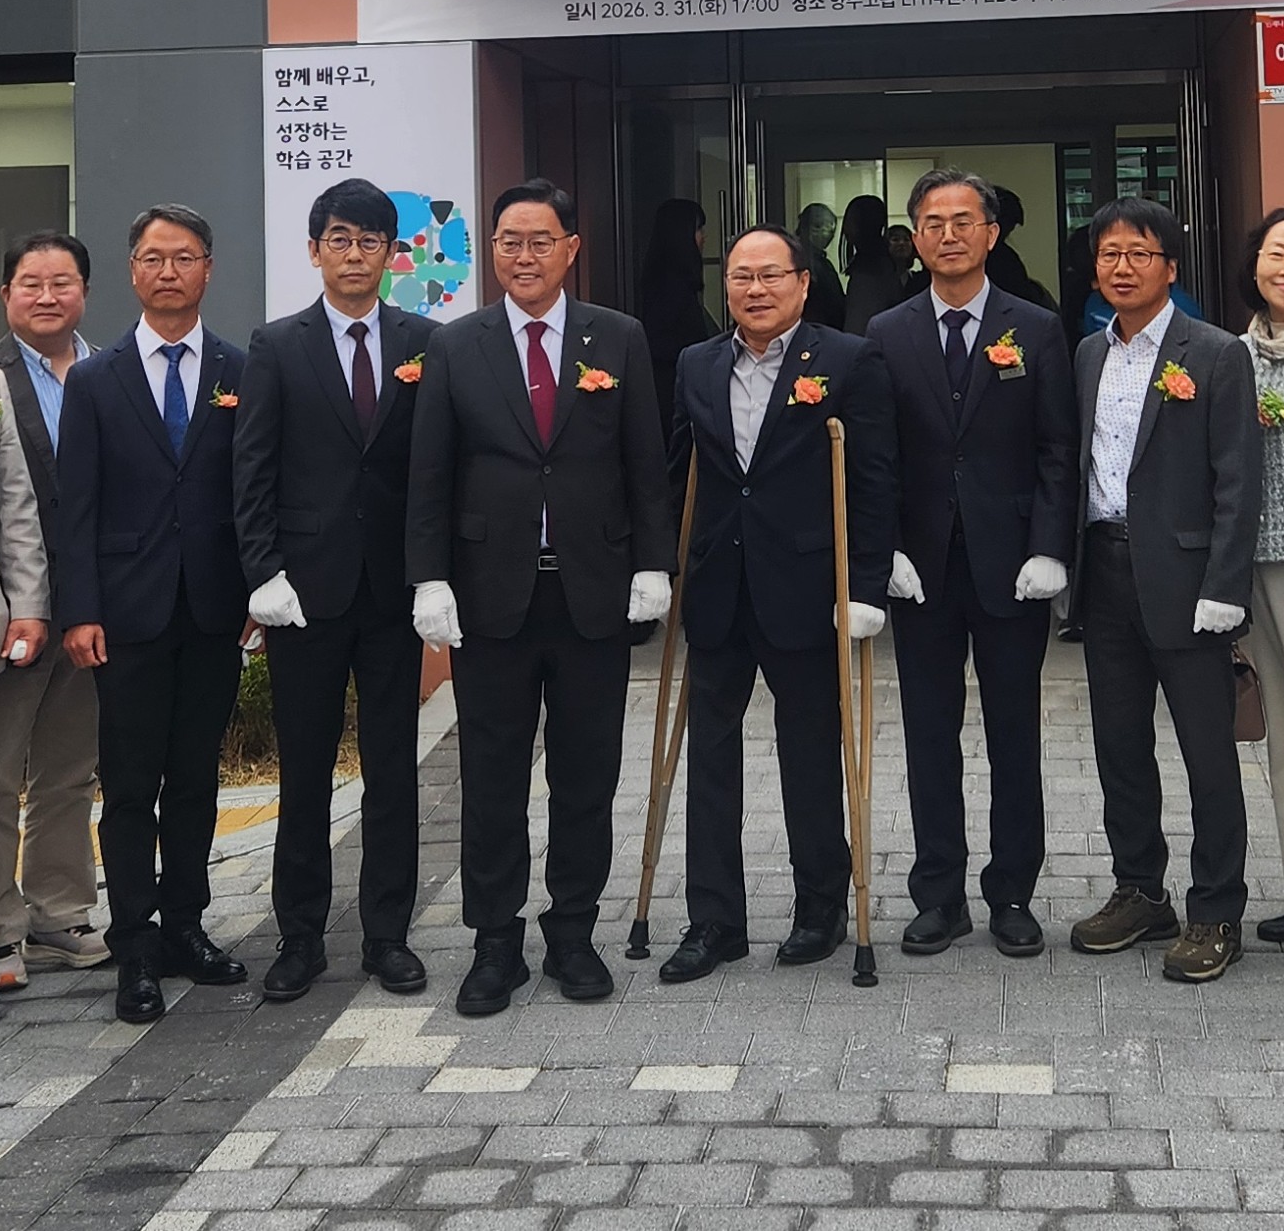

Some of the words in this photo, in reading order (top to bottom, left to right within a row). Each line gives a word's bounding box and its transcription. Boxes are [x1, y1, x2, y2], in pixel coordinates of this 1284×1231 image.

[564, 1, 596, 21] 일시
[601, 1, 649, 19] 2026.
[653, 0, 669, 17] 3.
[275, 67, 311, 87] 함께
[316, 66, 375, 87] 배우고,
[275, 96, 329, 112] 스스로
[276, 122, 348, 143] 성장하는
[276, 150, 312, 170] 학습
[317, 149, 353, 170] 공간
